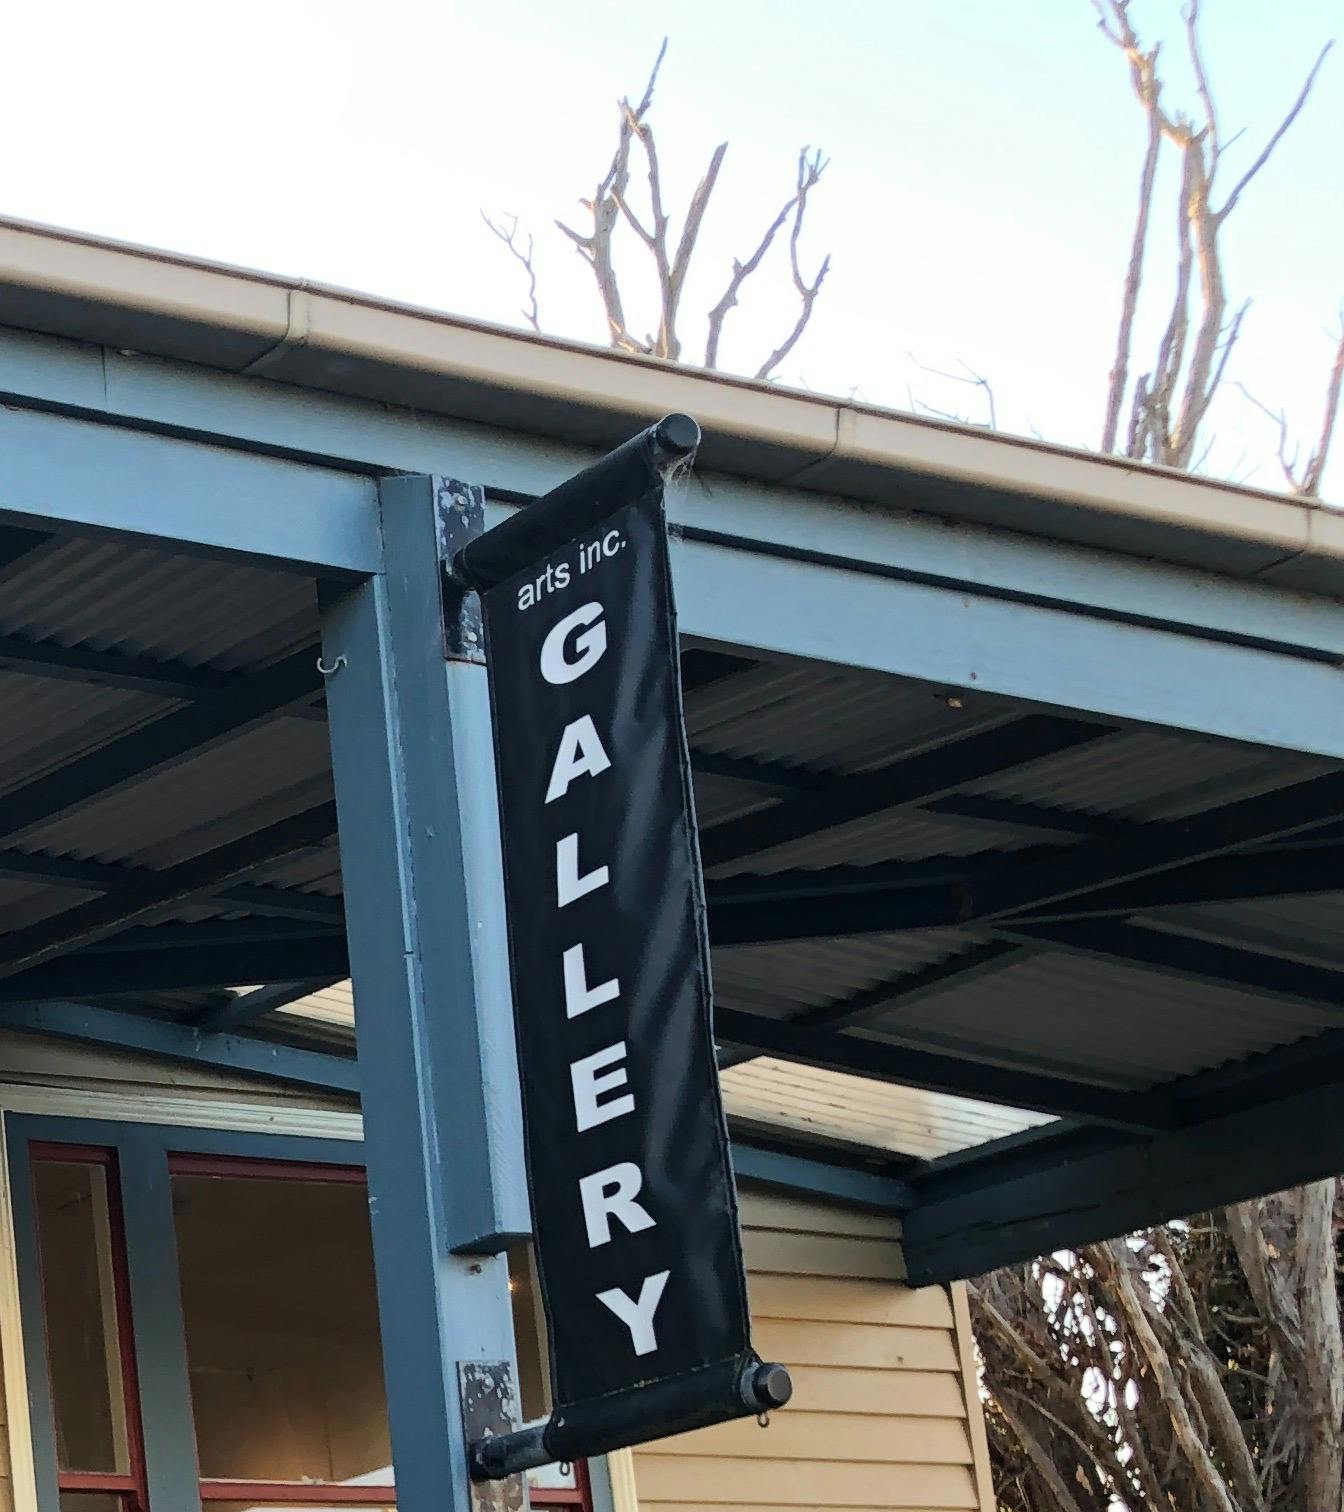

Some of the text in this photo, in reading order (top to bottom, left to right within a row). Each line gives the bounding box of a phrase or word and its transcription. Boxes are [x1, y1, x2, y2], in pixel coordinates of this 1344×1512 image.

[517, 528, 627, 612] arts inc.
[539, 601, 671, 1356] GALLERY
